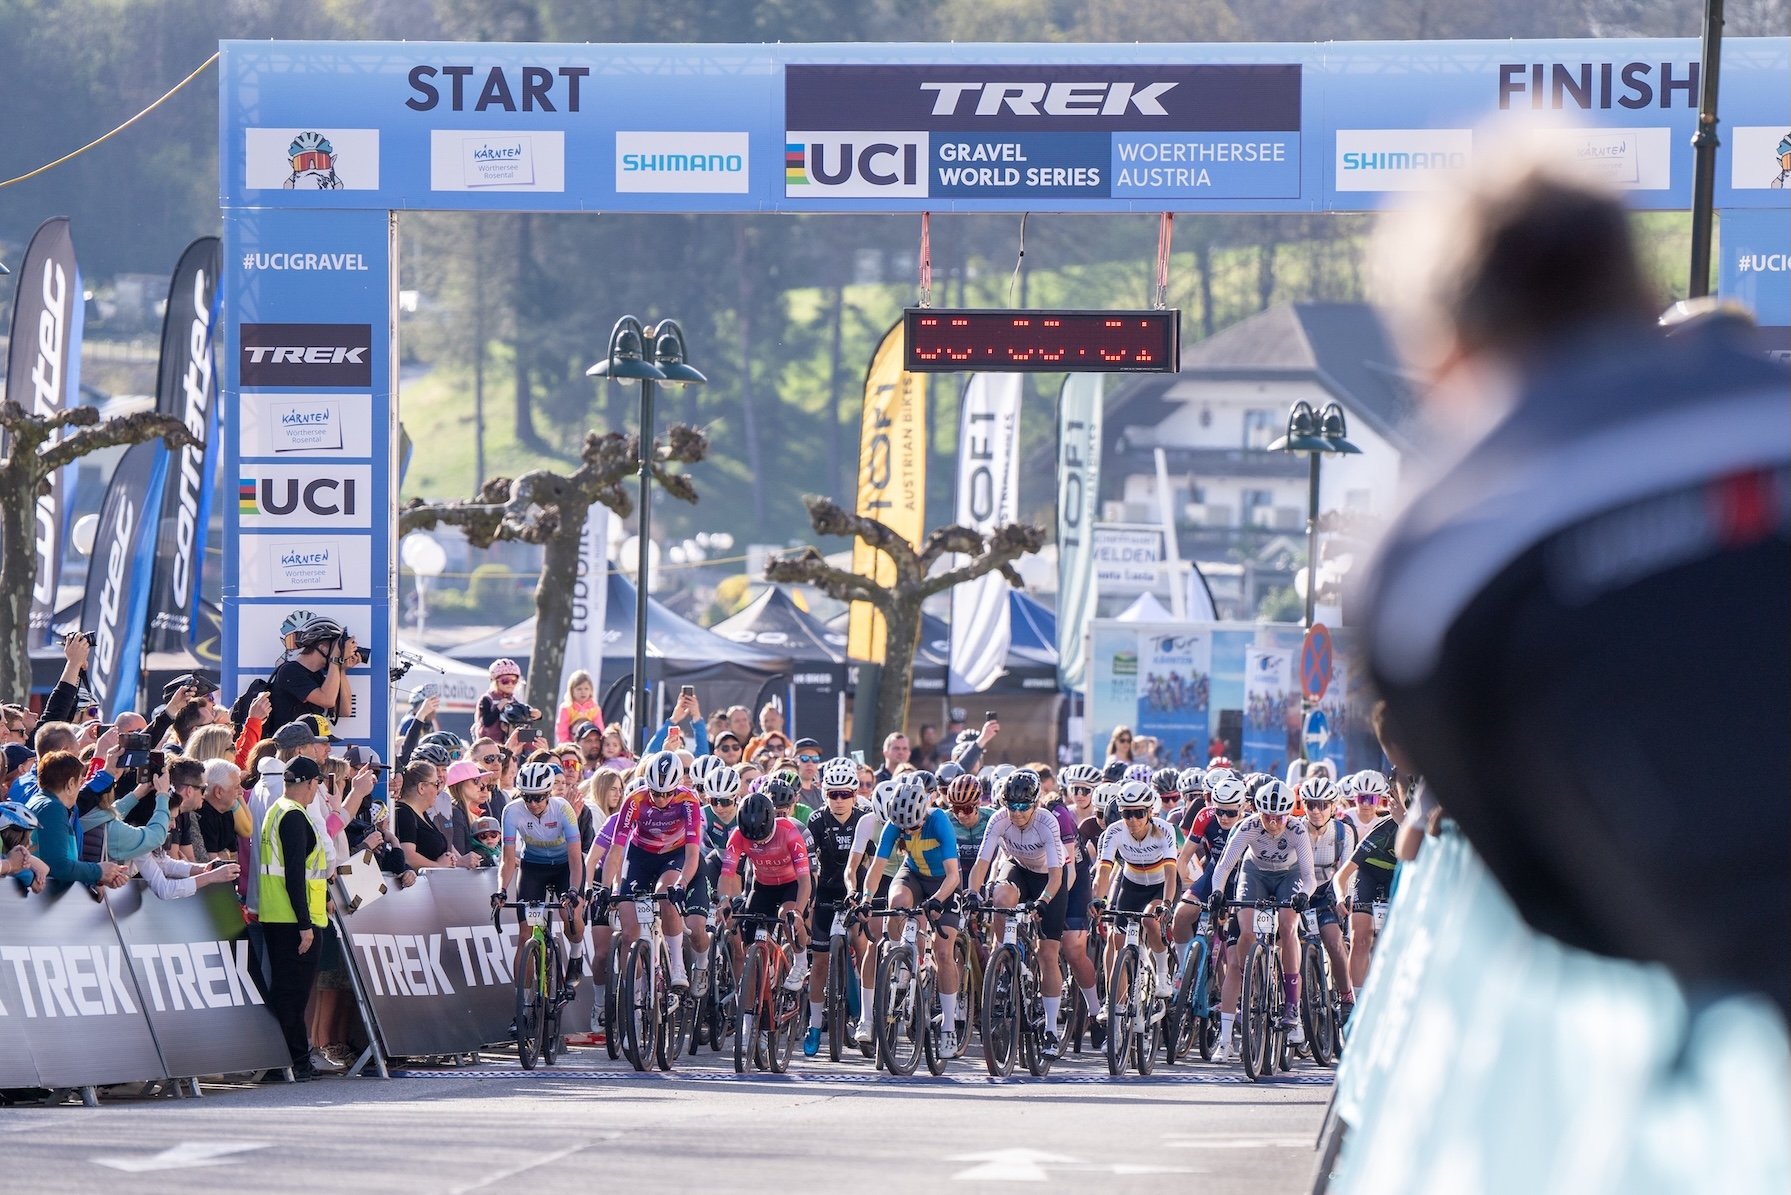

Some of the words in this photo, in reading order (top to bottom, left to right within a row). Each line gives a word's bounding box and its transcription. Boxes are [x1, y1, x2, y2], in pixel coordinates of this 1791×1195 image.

[405, 65, 590, 112] START
[919, 81, 1180, 116] TREK
[1500, 62, 1701, 110] FINISH
[622, 152, 743, 173] SHIMANO
[811, 142, 917, 186] UCI
[939, 143, 1027, 162] GRAVEL
[1118, 143, 1286, 162] WOERTHERSEE
[1342, 152, 1466, 170] SHIMANO
[938, 167, 1021, 187] WORLD
[1026, 167, 1101, 187] SERIES
[1117, 168, 1211, 187] AUSTRIA
[243, 252, 369, 272] #UCIGRAVEL
[1738, 254, 1791, 272] #UCI
[244, 346, 369, 364] TREK
[902, 377, 914, 423] BIKES
[902, 429, 915, 511] AUSTRIAN
[261, 478, 356, 516] UCI
[1123, 843, 1160, 854] CANYON
[352, 933, 455, 997] TREK
[446, 922, 521, 987] TRE
[2, 944, 138, 1018] TREK
[129, 939, 265, 1012] TREK
